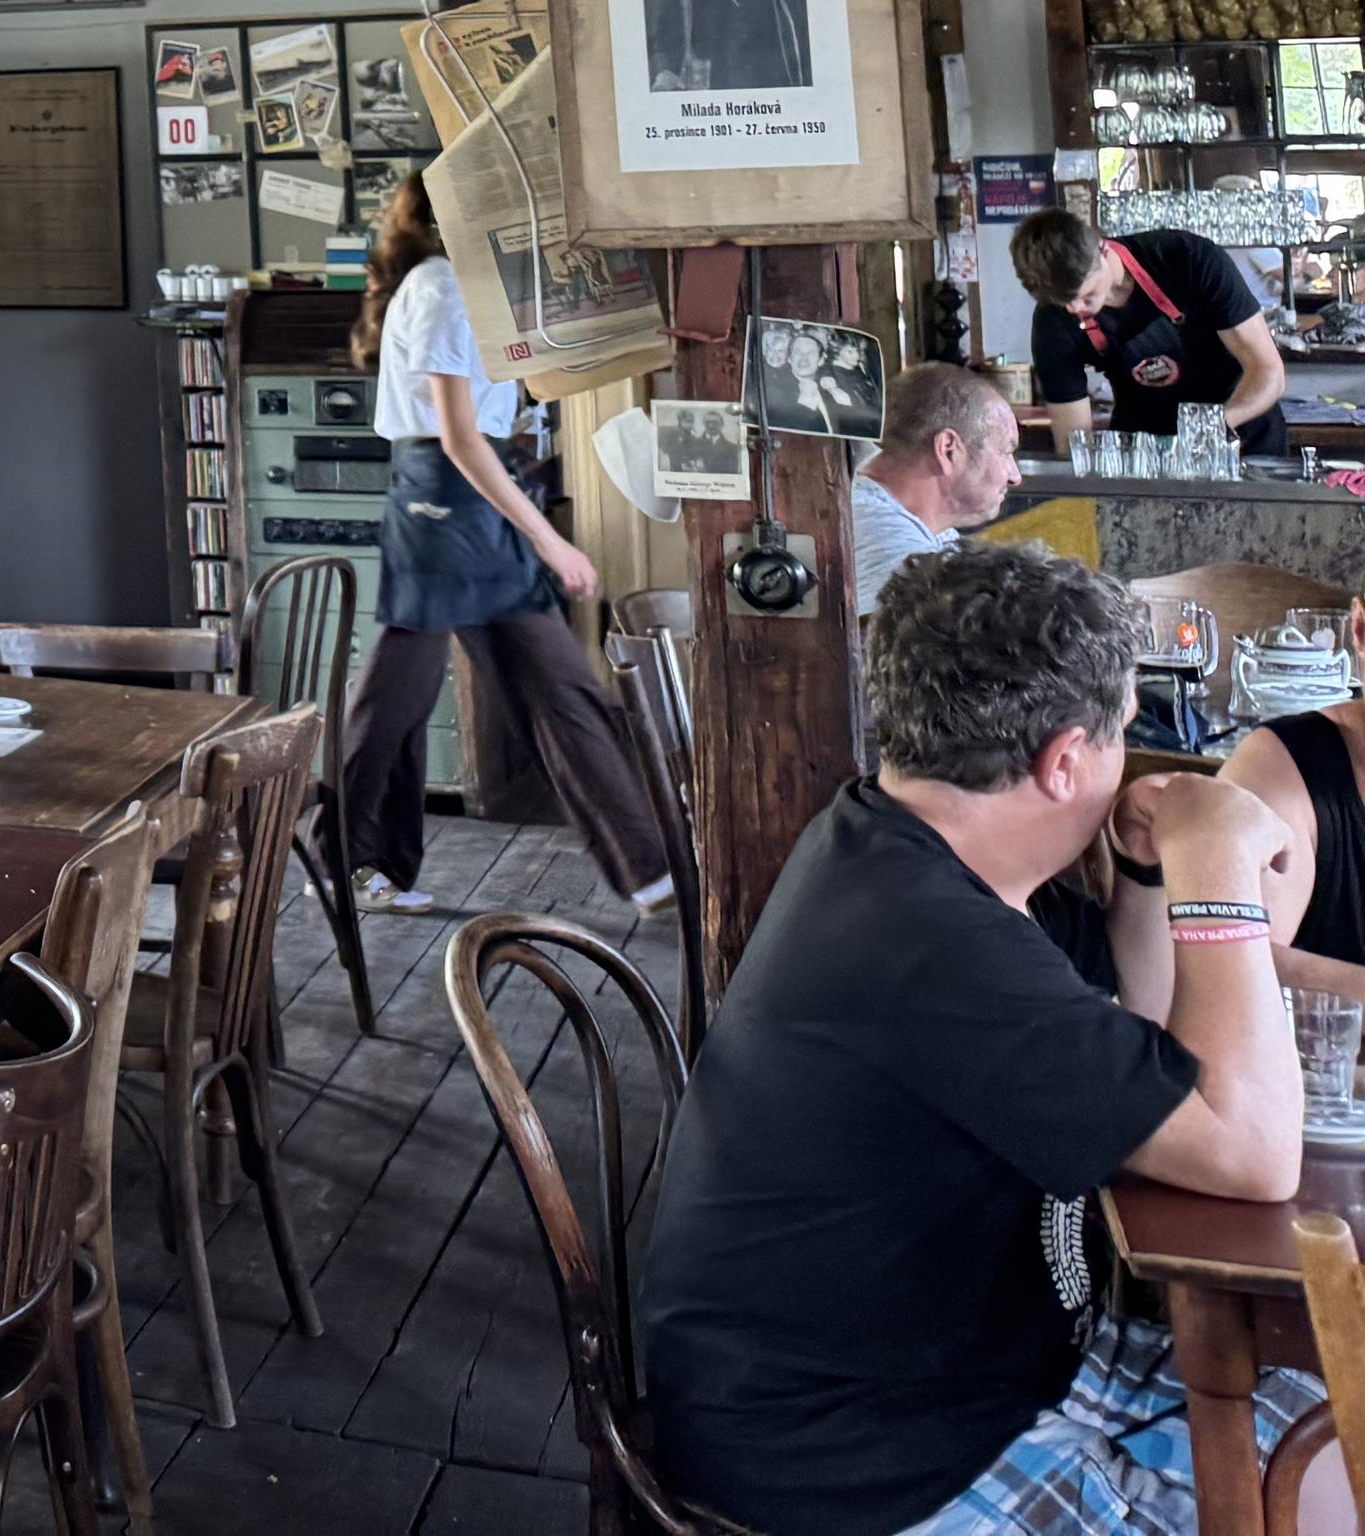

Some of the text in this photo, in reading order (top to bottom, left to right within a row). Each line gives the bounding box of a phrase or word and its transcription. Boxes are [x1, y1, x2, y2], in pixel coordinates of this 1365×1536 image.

[680, 99, 782, 118] Milada Horáková
[645, 126, 661, 139] 25.
[664, 124, 707, 140] prosince
[710, 123, 733, 137] 1901
[745, 123, 762, 136] 27.
[765, 122, 799, 136] června
[802, 121, 827, 134] 1950
